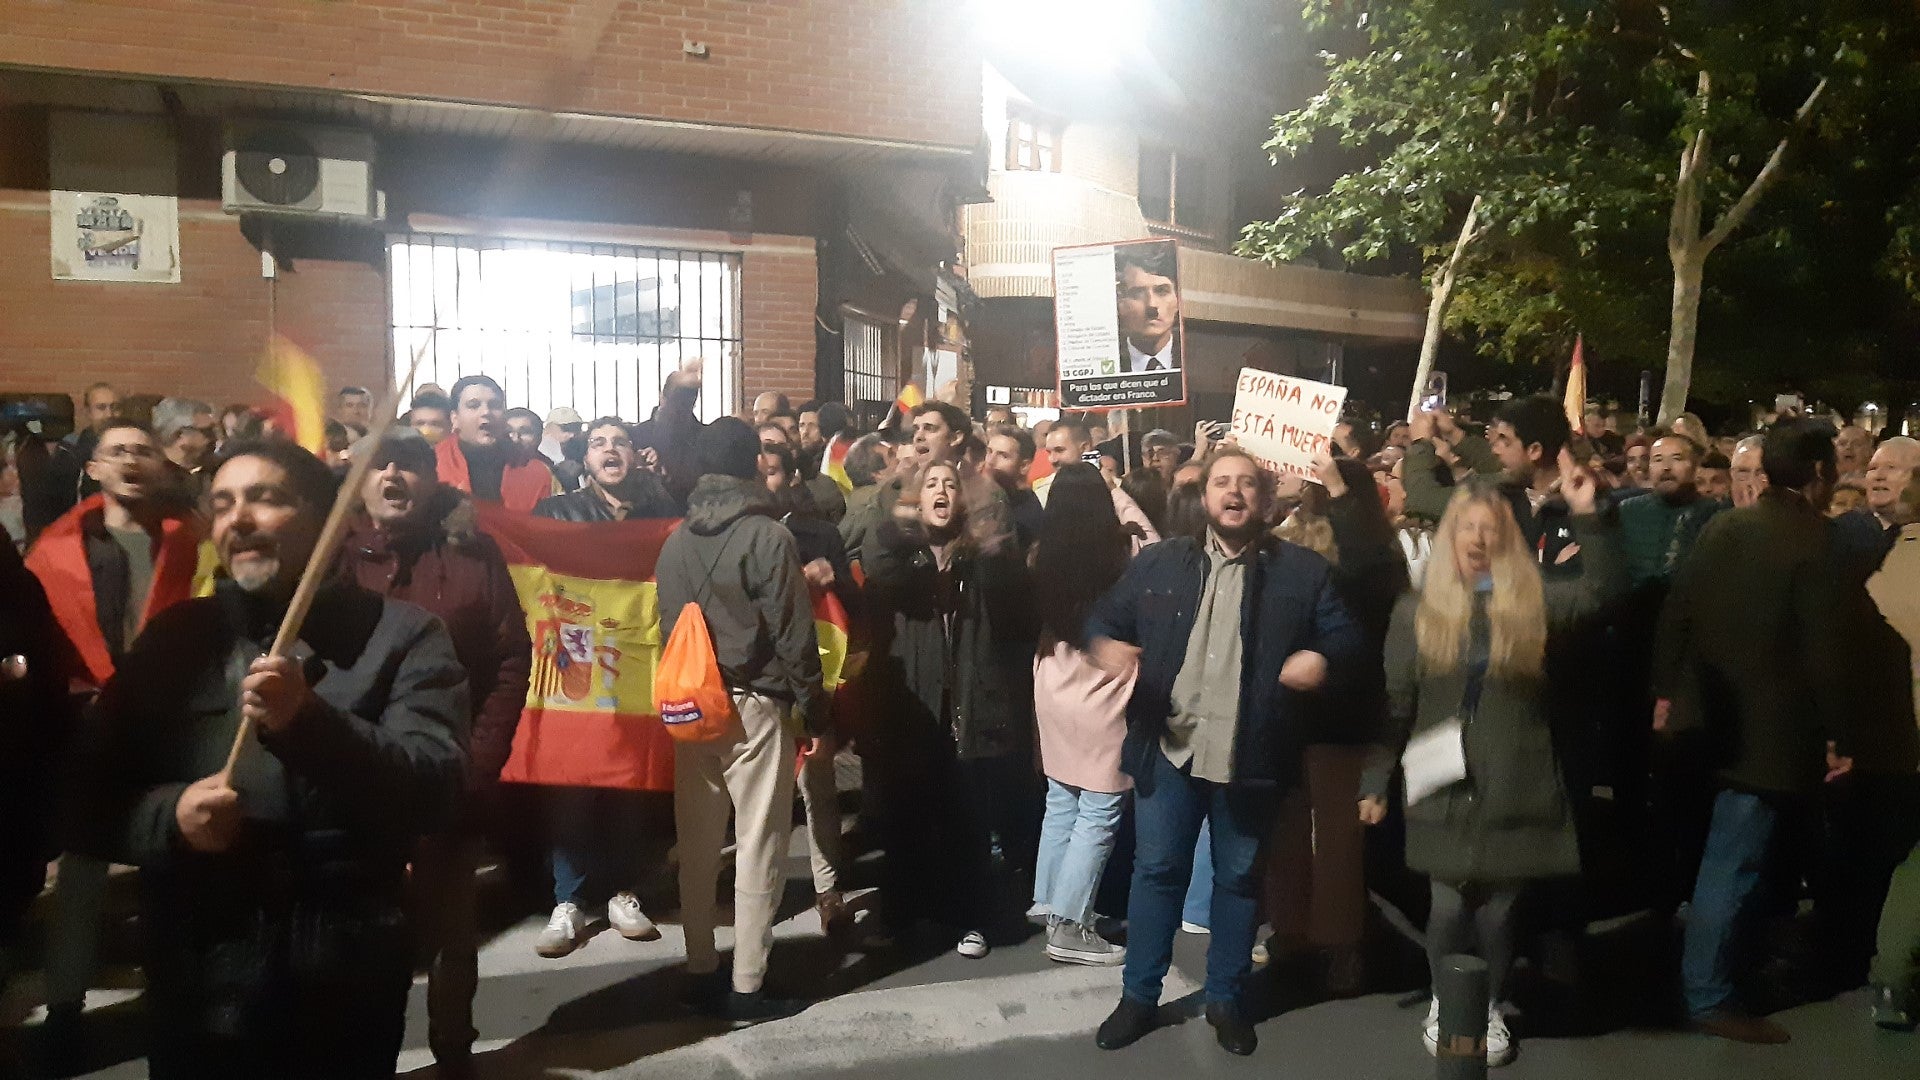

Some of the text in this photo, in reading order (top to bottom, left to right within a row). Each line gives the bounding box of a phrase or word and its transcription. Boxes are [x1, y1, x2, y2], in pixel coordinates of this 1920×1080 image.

[1073, 368, 1094, 376] CGPJ
[1069, 377, 1169, 392] Para los que dicen que el
[1078, 393, 1111, 402] dictador
[1127, 390, 1157, 399] Franco.
[1239, 374, 1338, 414] ESPAÑA NO
[1232, 408, 1276, 440] ESTÁ
